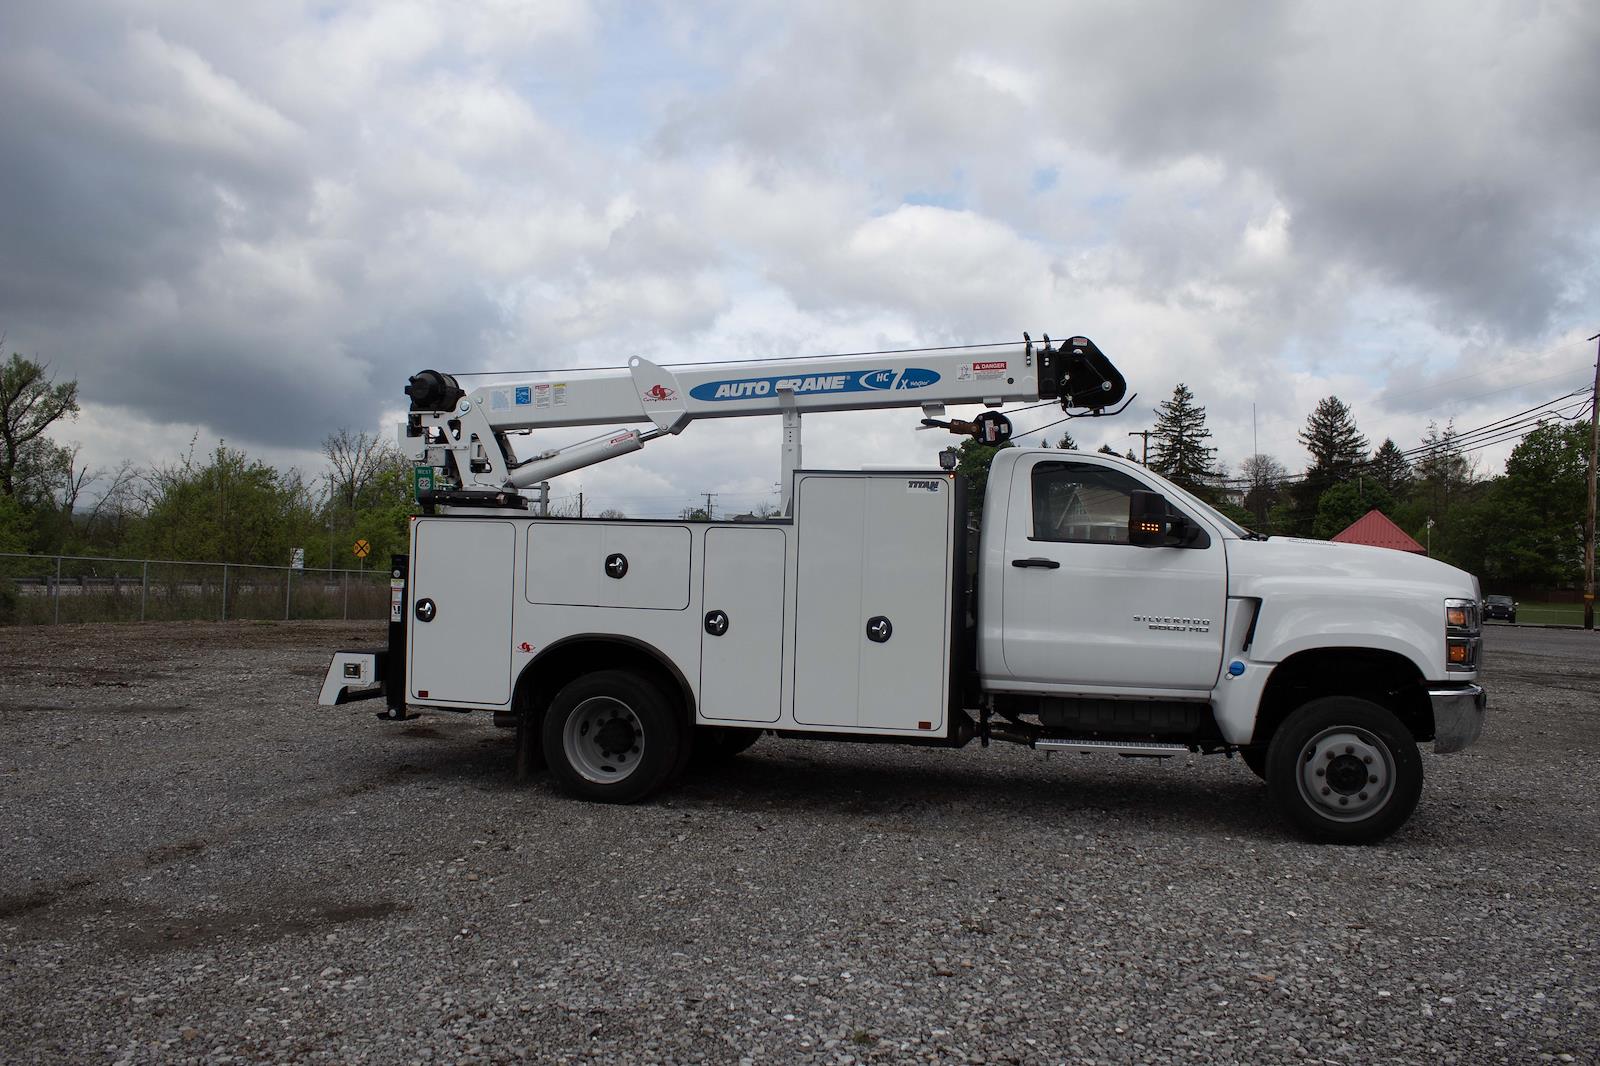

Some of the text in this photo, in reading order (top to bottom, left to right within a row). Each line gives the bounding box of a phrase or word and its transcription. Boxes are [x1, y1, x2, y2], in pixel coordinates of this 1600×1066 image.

[981, 362, 1005, 370] DANGER
[876, 373, 890, 382] HC
[714, 375, 845, 398] AUTO CRANE
[419, 479, 430, 488] 22
[1133, 615, 1210, 626] SILVERADO
